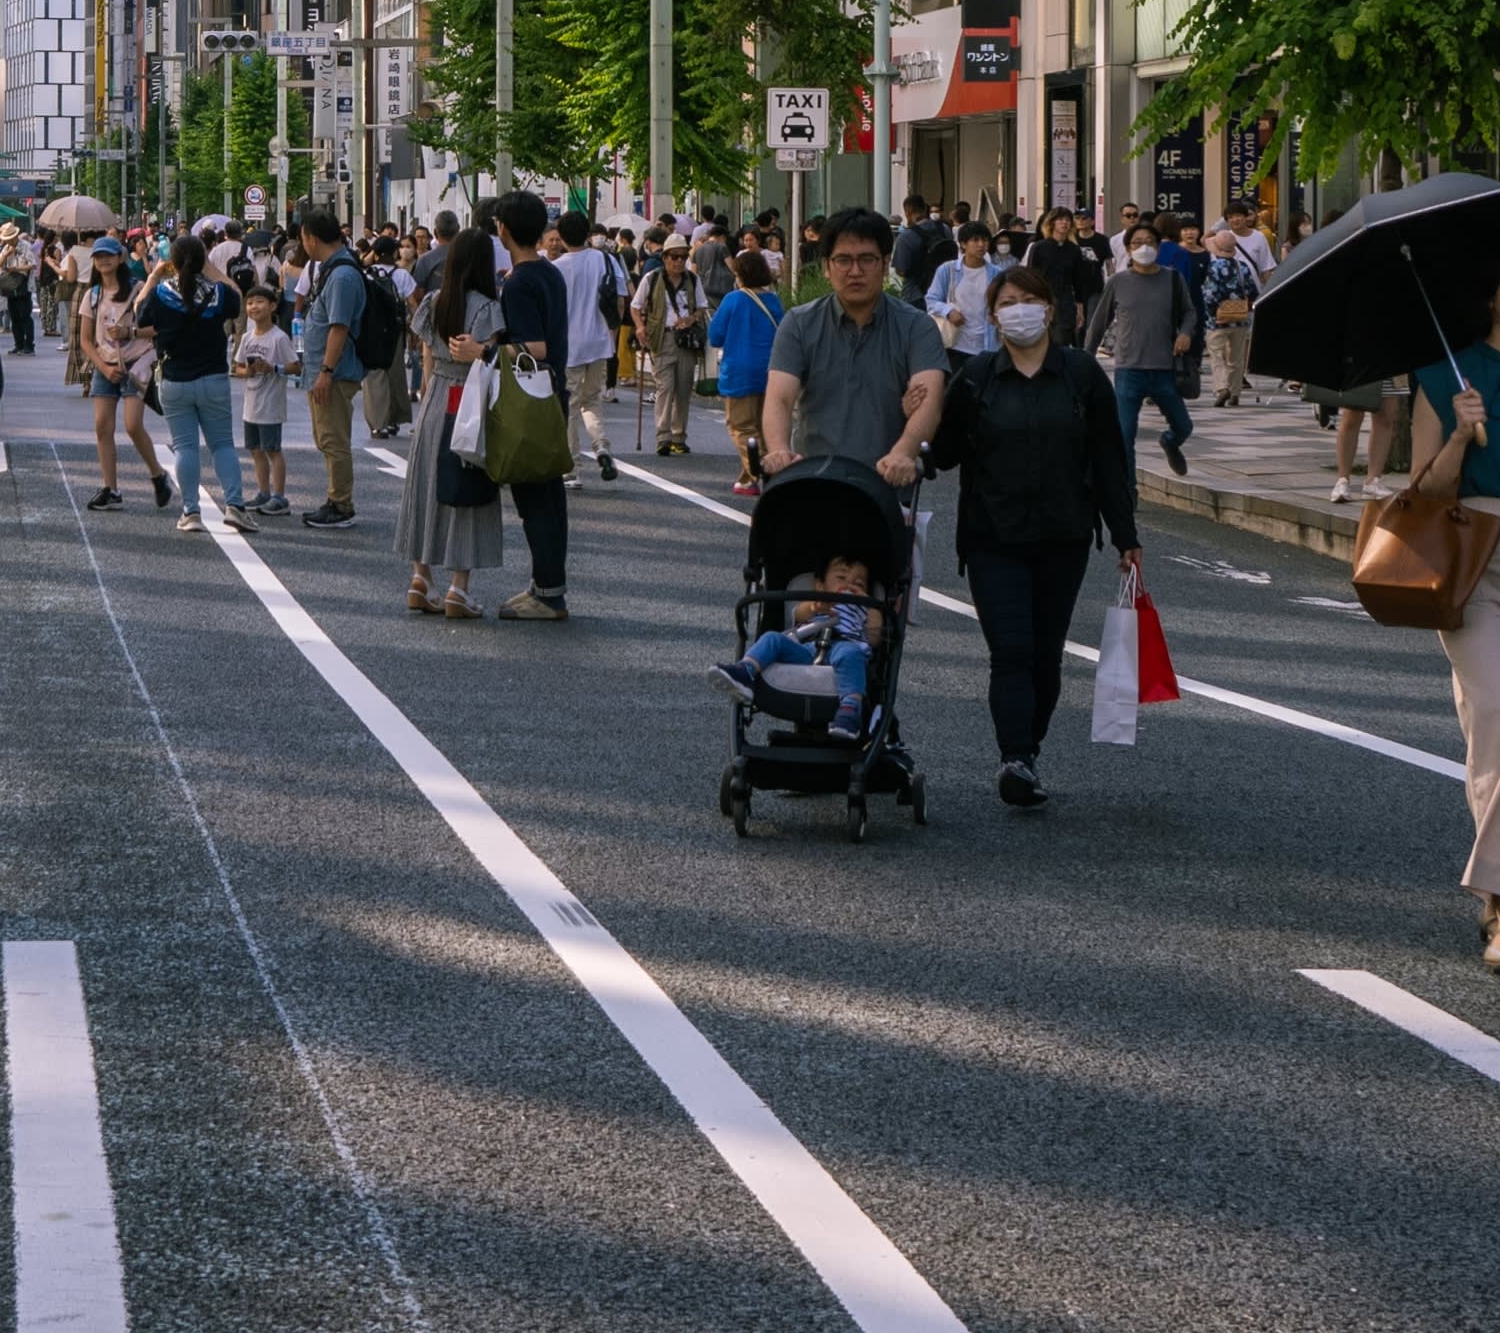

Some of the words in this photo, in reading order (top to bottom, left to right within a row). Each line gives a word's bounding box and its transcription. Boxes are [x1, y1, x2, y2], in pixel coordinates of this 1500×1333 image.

[271, 36, 326, 48] 銀座五丁目
[966, 52, 1010, 62] ワシントン
[320, 56, 336, 111] DINA
[775, 94, 822, 109] TAXI
[1231, 133, 1242, 163] PICK
[1244, 133, 1255, 158] BUY
[1157, 149, 1182, 168] 4F
[1231, 167, 1241, 185] UP
[1157, 192, 1181, 211] 3F
